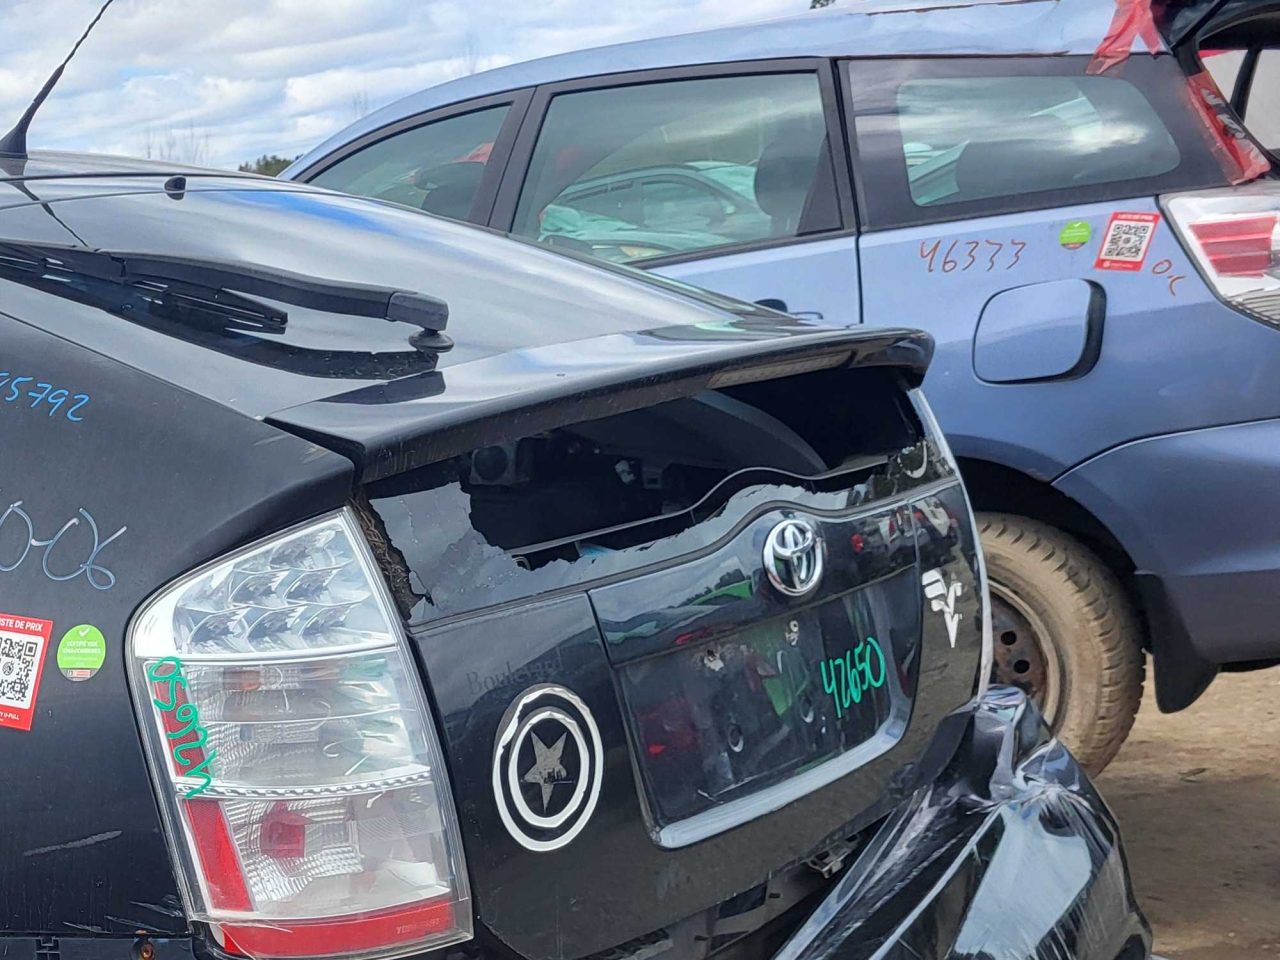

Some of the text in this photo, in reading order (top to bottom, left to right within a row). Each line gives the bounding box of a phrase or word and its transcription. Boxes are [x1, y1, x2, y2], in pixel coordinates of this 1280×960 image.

[920, 239, 1027, 272] 46333
[14, 620, 25, 630] DE
[25, 621, 43, 632] PRIX
[821, 637, 886, 718] 42650
